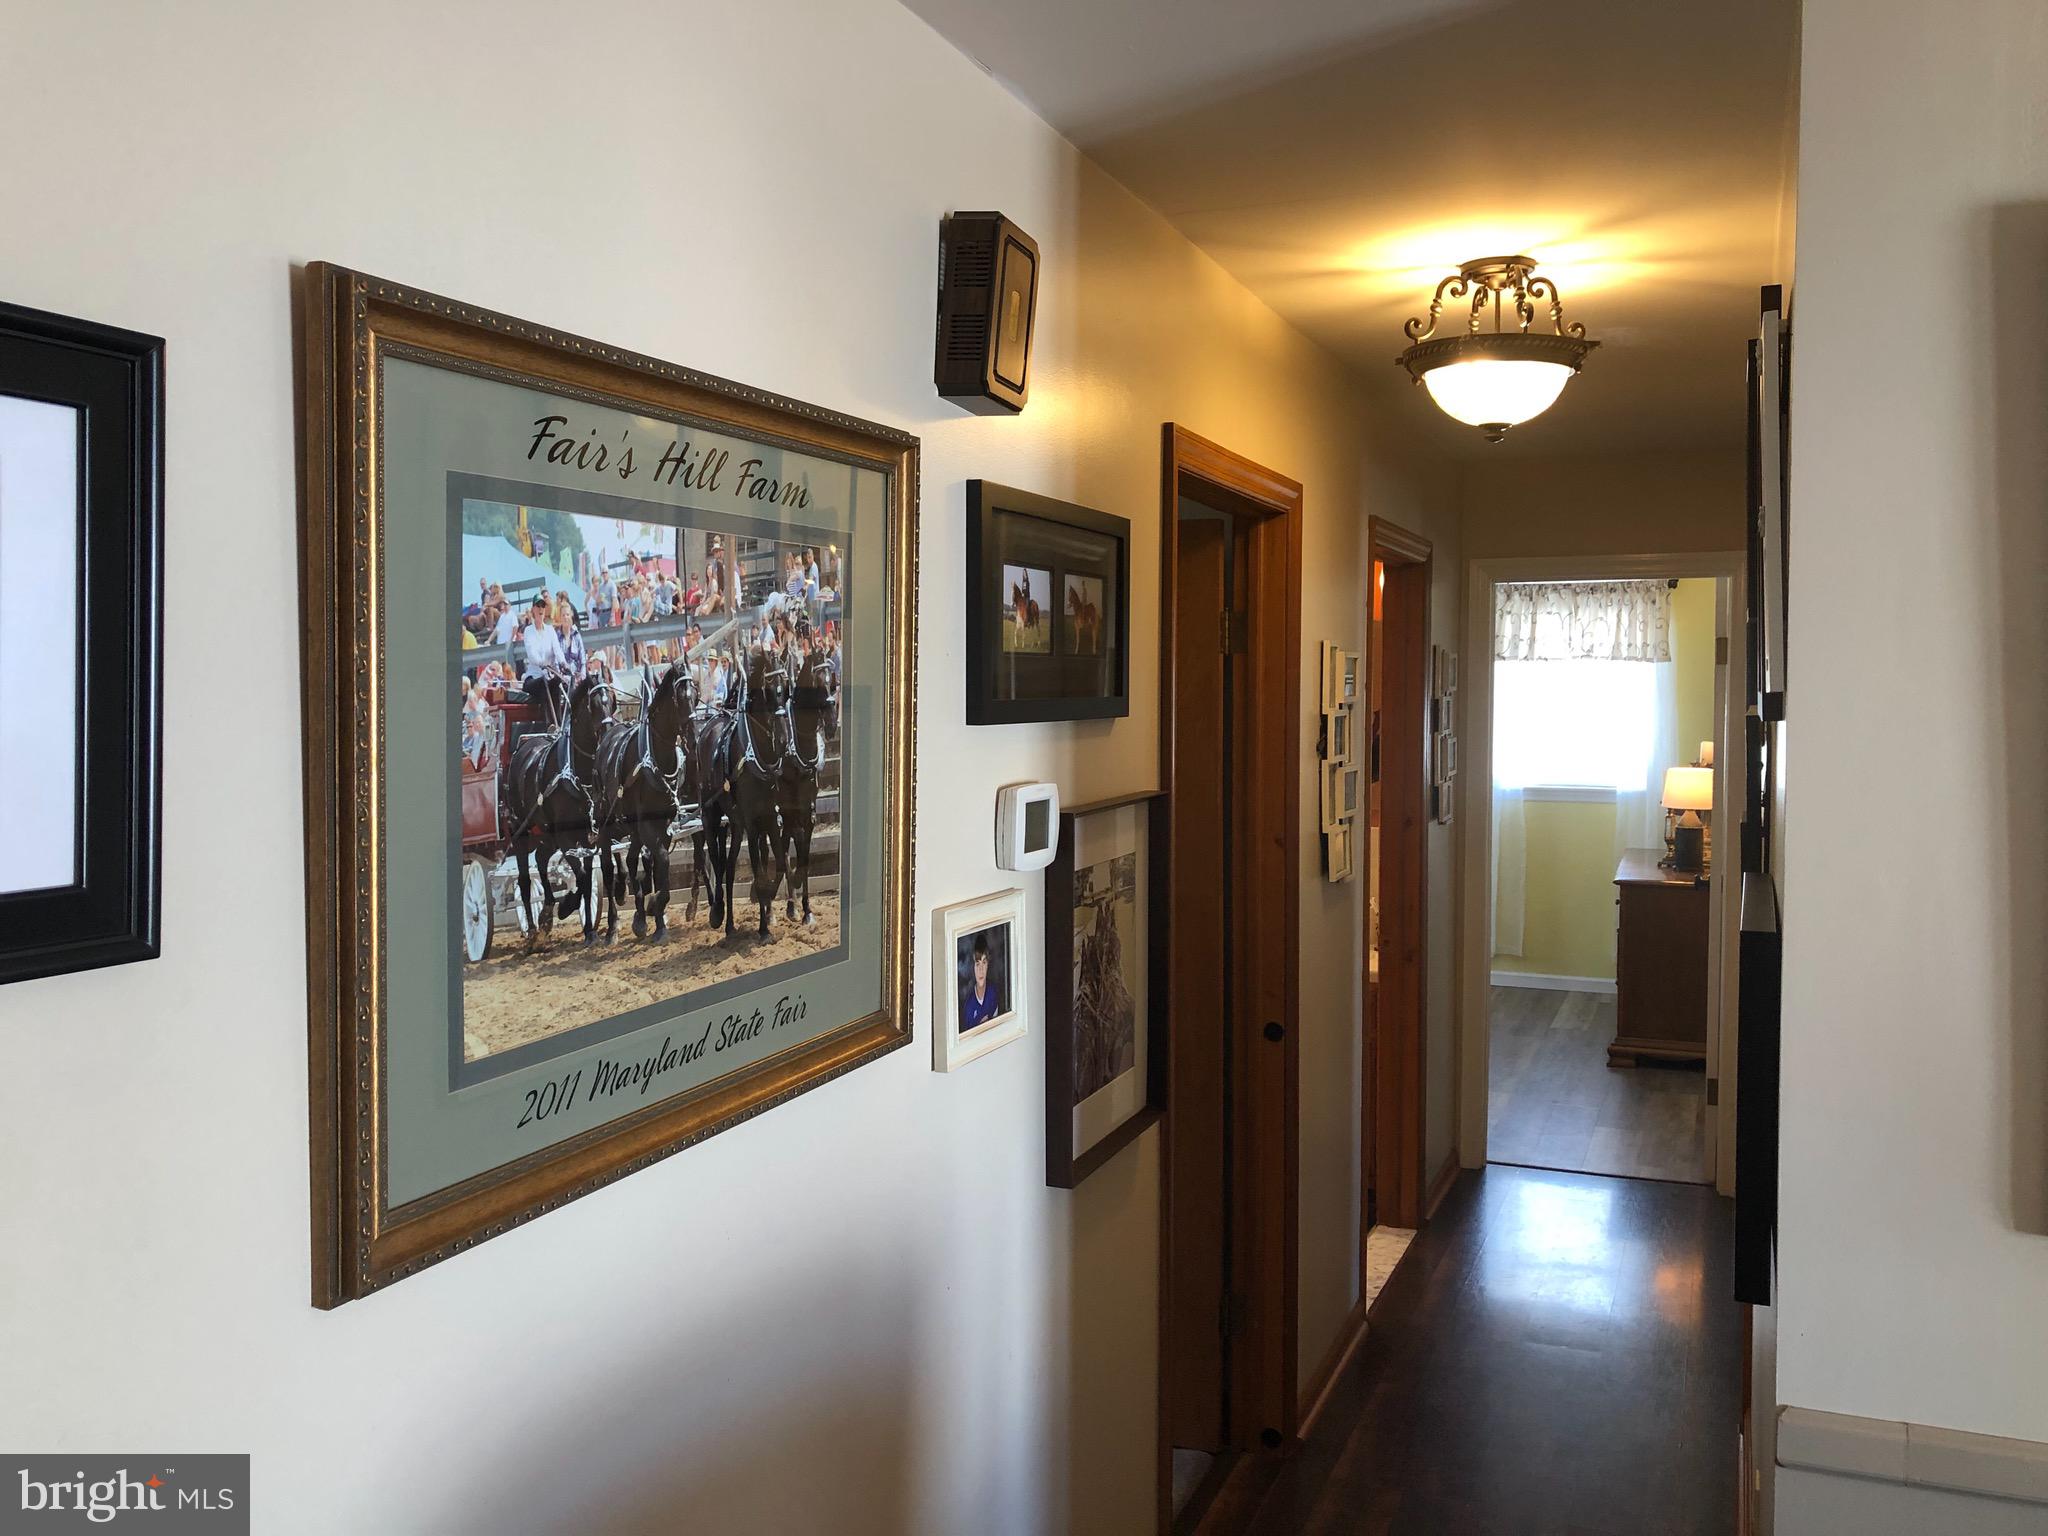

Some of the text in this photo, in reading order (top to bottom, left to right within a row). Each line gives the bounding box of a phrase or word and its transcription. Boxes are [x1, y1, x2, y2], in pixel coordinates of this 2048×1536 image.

[527, 415, 810, 509] Fair's Hill Farm
[516, 994, 808, 1129] 2011 Maryland State Fair
